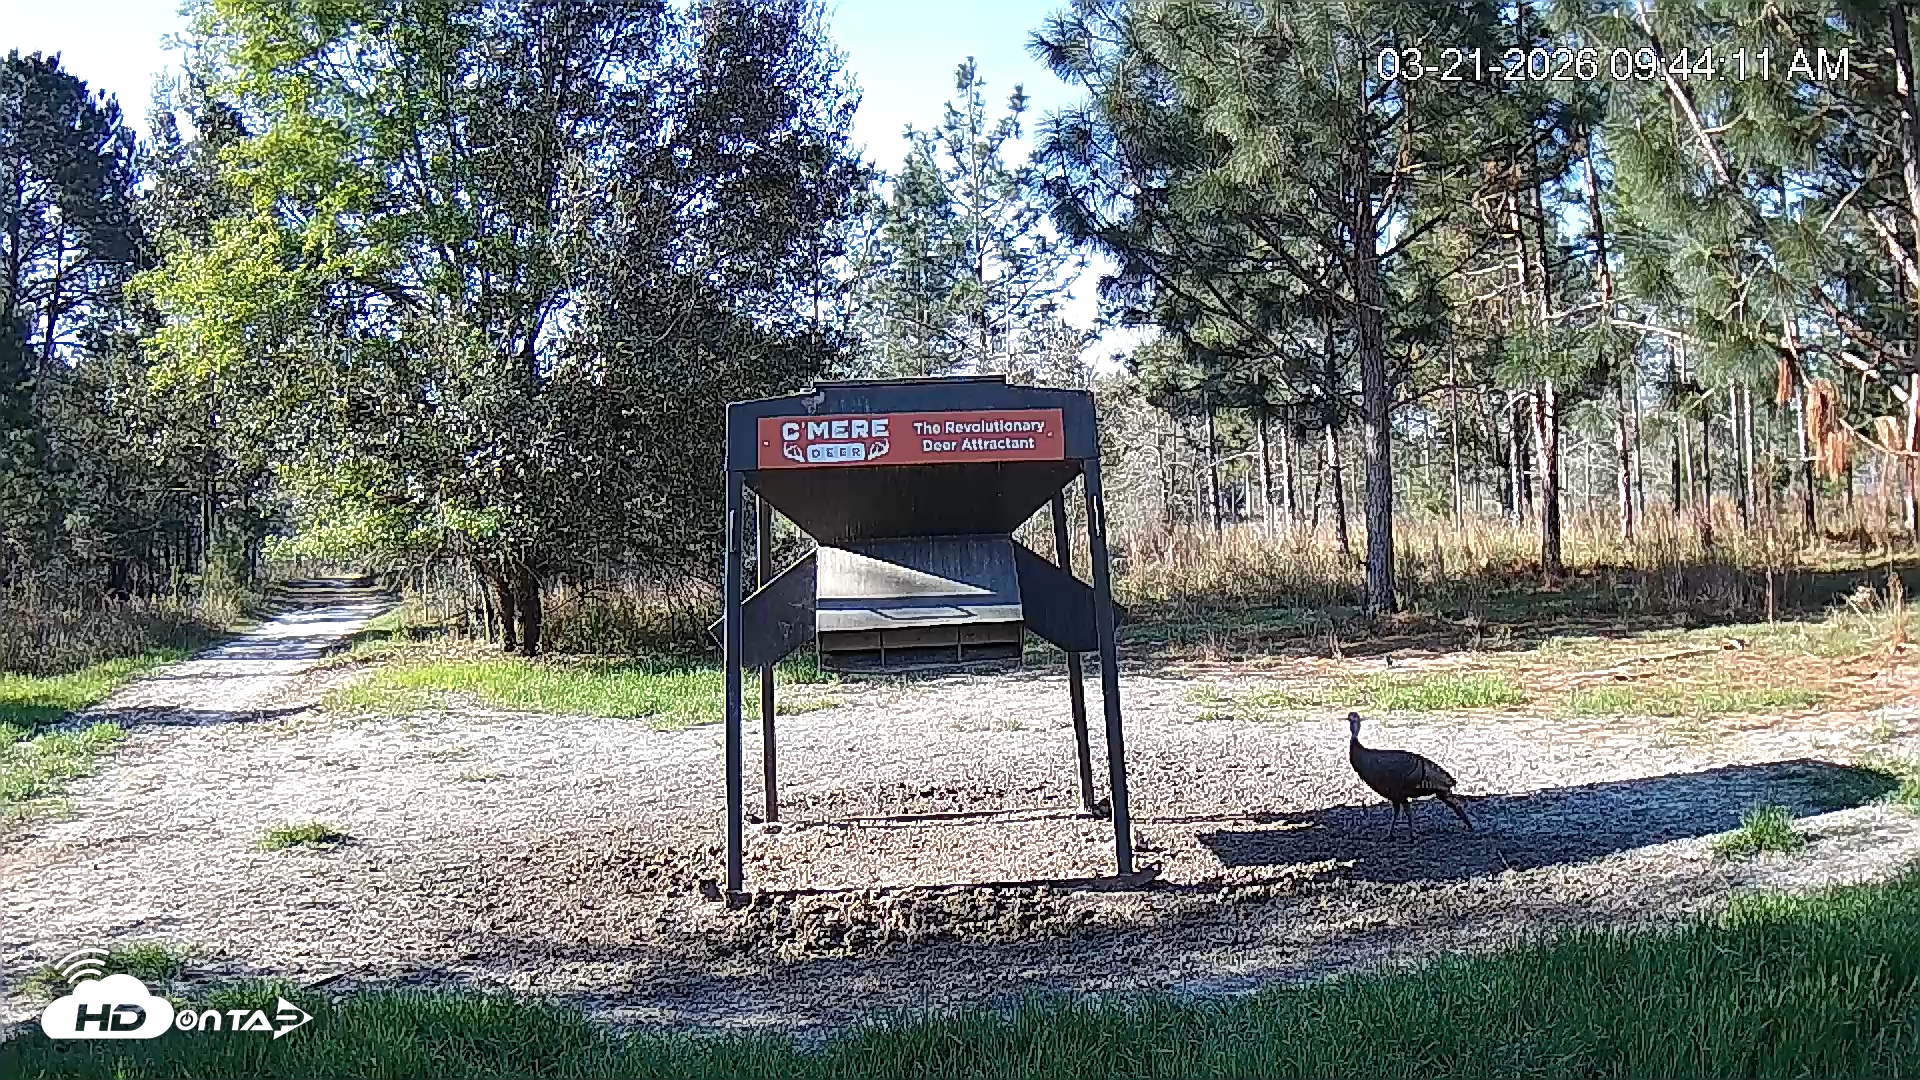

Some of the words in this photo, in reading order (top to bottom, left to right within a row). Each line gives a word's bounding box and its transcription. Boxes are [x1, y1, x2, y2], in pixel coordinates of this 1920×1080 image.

[782, 419, 889, 440] C'MERE
[913, 422, 940, 434] The
[945, 420, 1045, 434] Revolutionary
[923, 439, 957, 451] Deer
[961, 437, 1035, 451] Attractant
[811, 447, 861, 459] DEER
